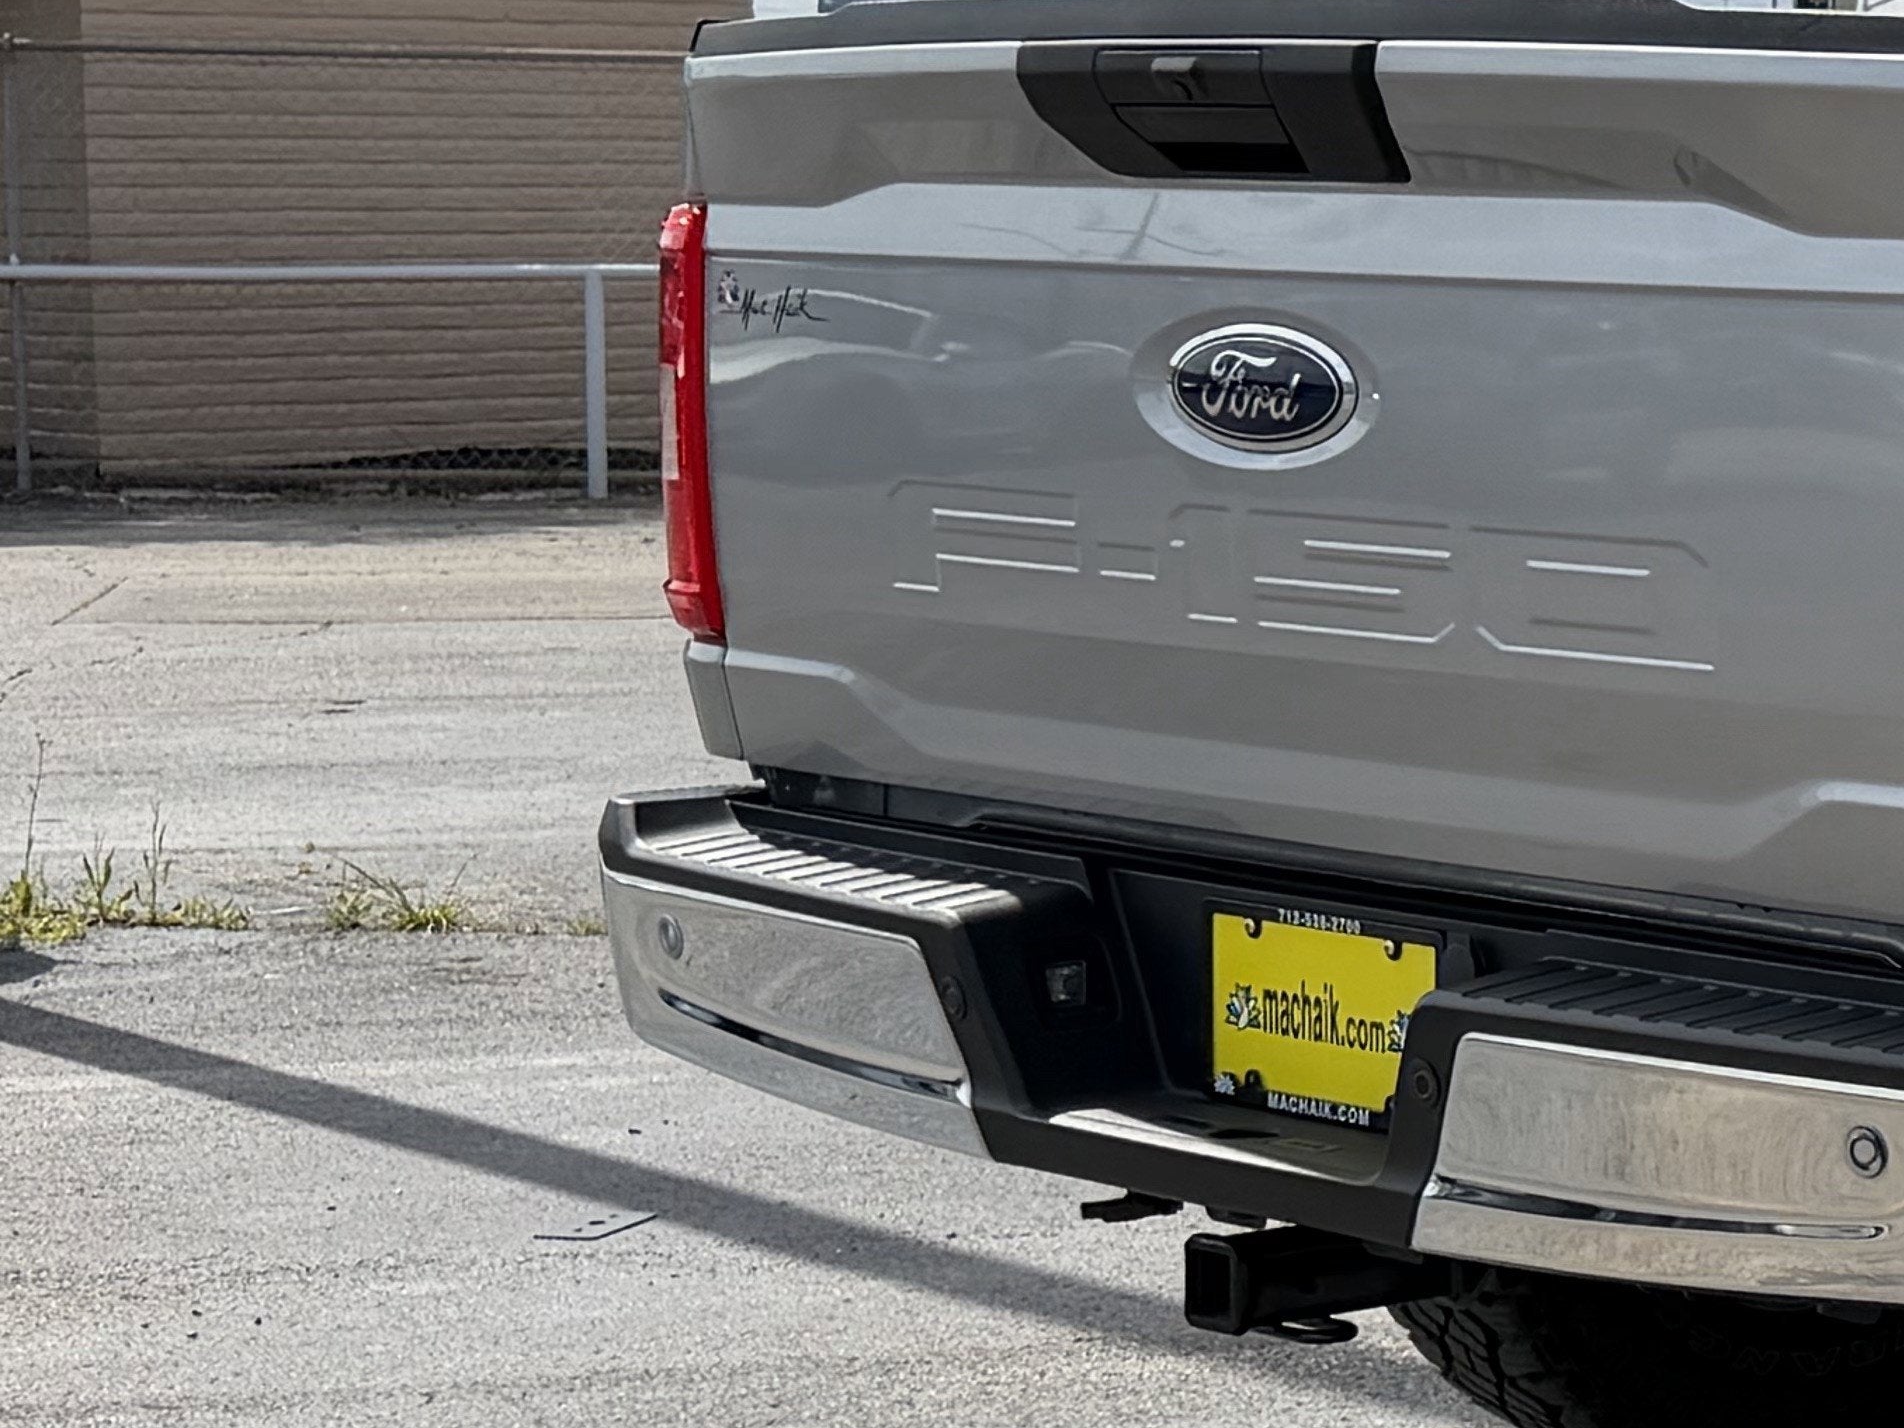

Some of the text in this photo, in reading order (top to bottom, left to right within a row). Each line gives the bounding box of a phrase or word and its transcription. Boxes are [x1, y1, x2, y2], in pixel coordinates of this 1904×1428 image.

[1202, 349, 1300, 422] Ford
[887, 479, 1714, 671] F-150
[1262, 979, 1386, 1054] machaik.com
[1267, 1091, 1370, 1127] MACHAIK.COM
